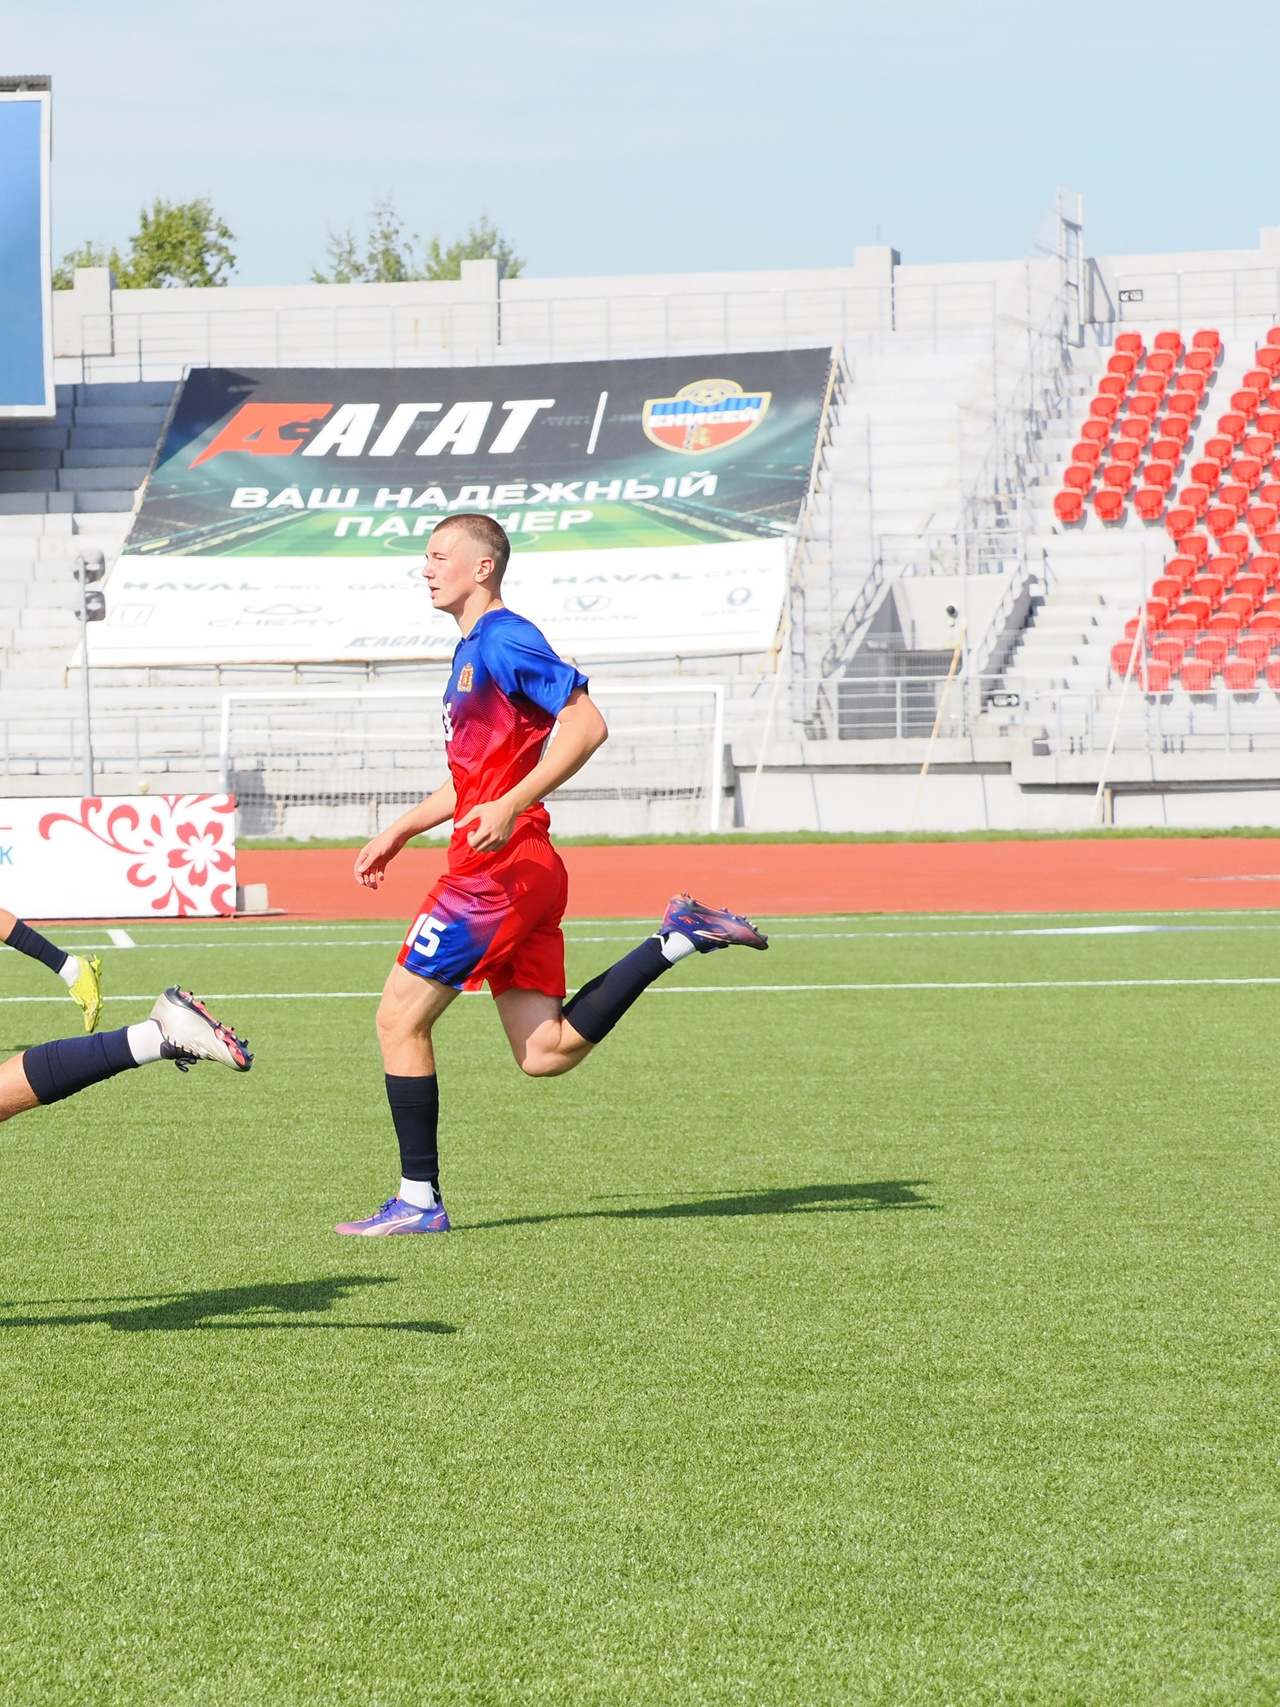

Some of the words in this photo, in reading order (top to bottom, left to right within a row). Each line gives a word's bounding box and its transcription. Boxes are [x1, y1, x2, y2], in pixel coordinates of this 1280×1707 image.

[302, 399, 556, 457] АГАТ
[647, 406, 760, 428] ЕНИСЕЙ
[230, 486, 360, 509] ВАШ
[374, 471, 718, 513] НАДЕЖНЫЙ
[334, 510, 594, 538] ПАРНЕР
[122, 582, 262, 592] HAVAL
[551, 572, 695, 585] HAVAL
[207, 617, 343, 628] CHERY
[405, 913, 447, 957] 15
